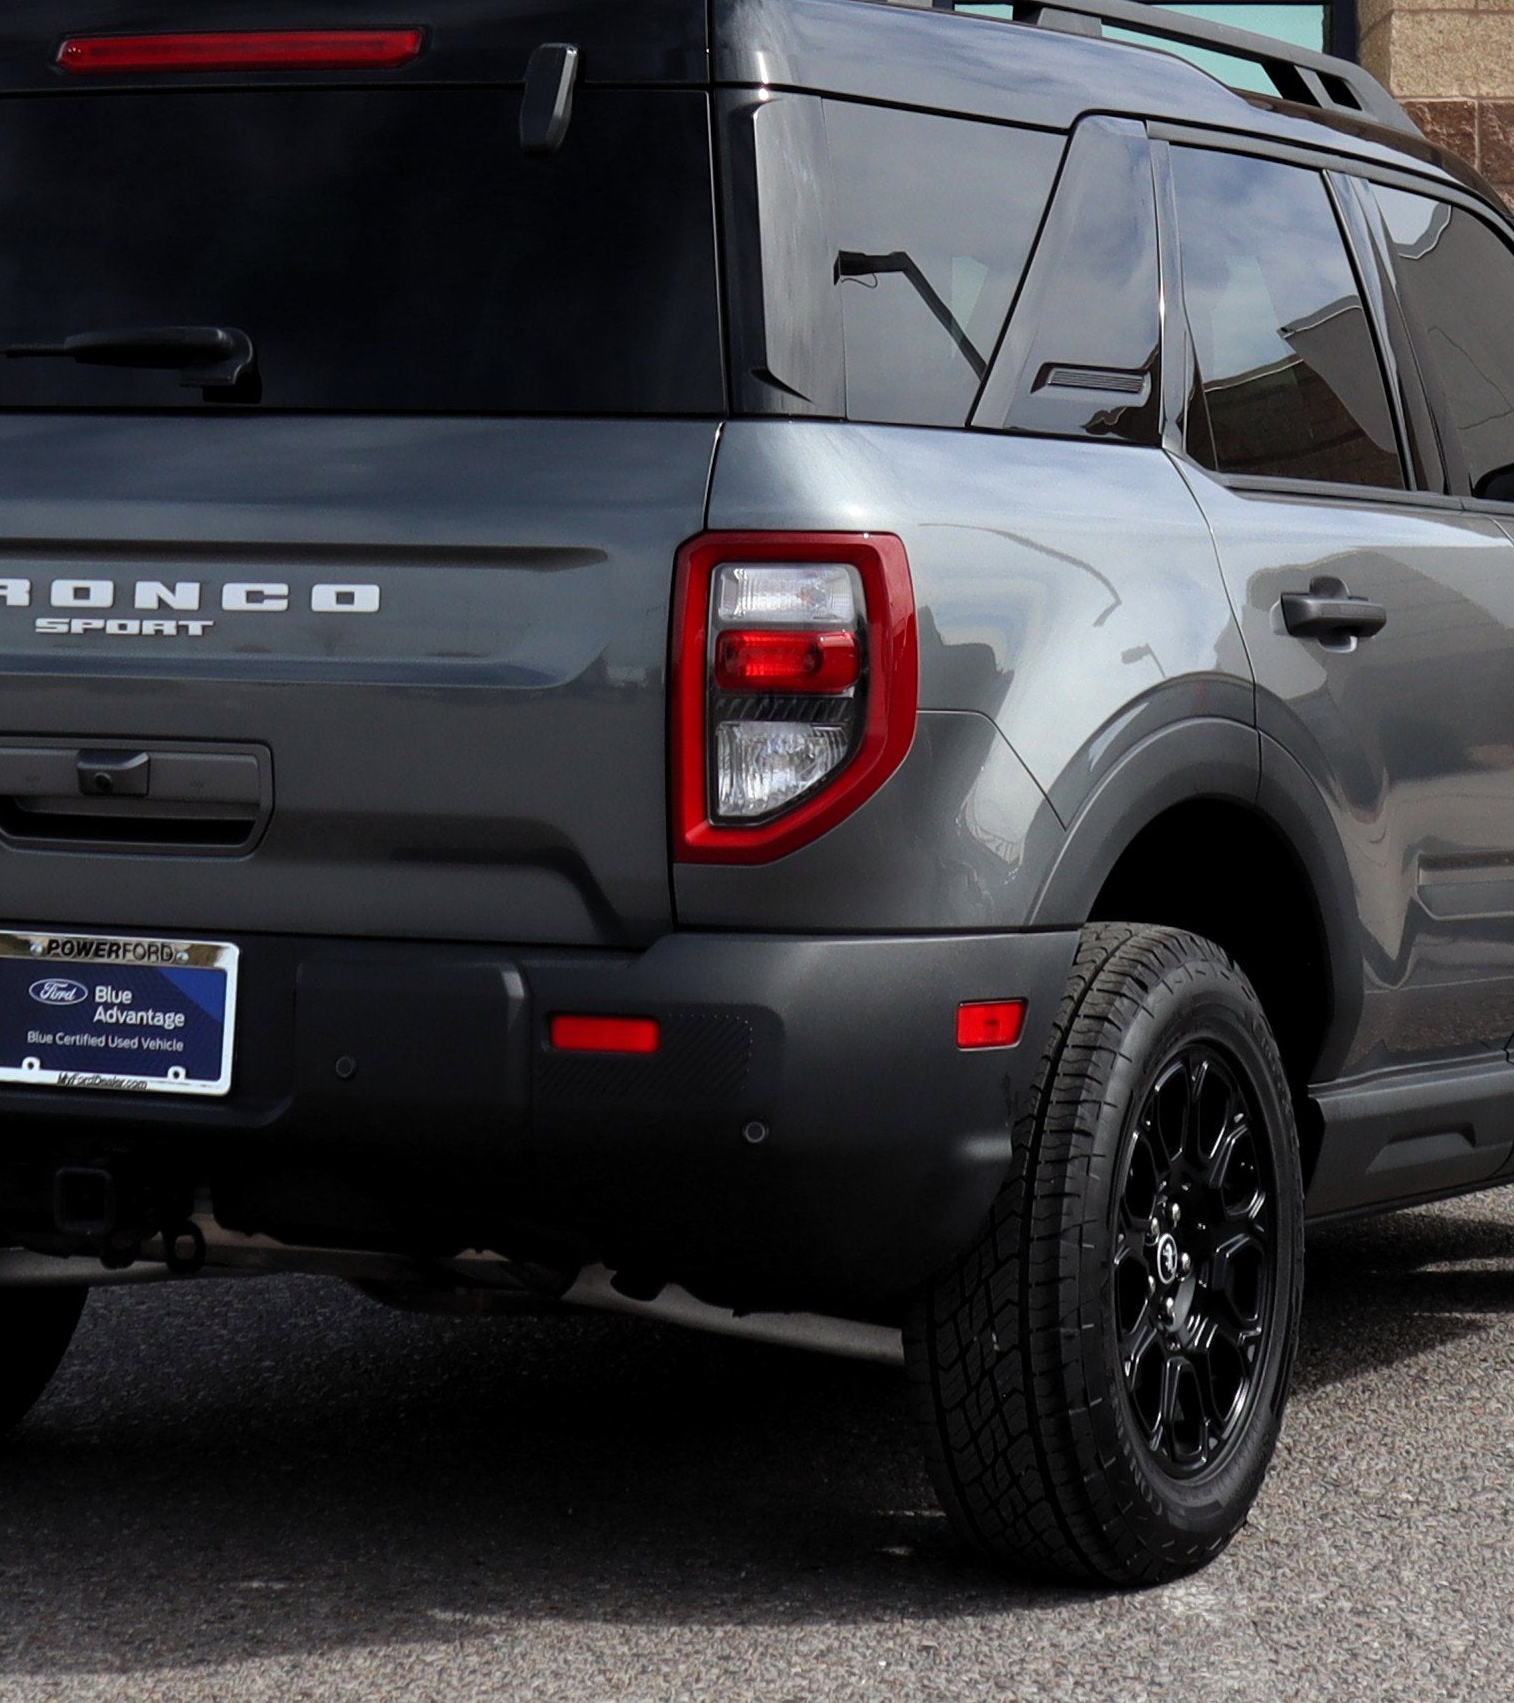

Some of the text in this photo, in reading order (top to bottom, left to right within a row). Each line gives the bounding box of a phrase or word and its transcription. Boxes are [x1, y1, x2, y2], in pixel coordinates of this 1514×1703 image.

[34, 618, 214, 637] SPORT
[47, 939, 174, 963] POWERFORD
[39, 981, 78, 1002] Ford
[94, 985, 133, 1004] Blue
[93, 1005, 186, 1029] Advantage
[27, 1030, 184, 1052] Blue Certified Used Vehicle
